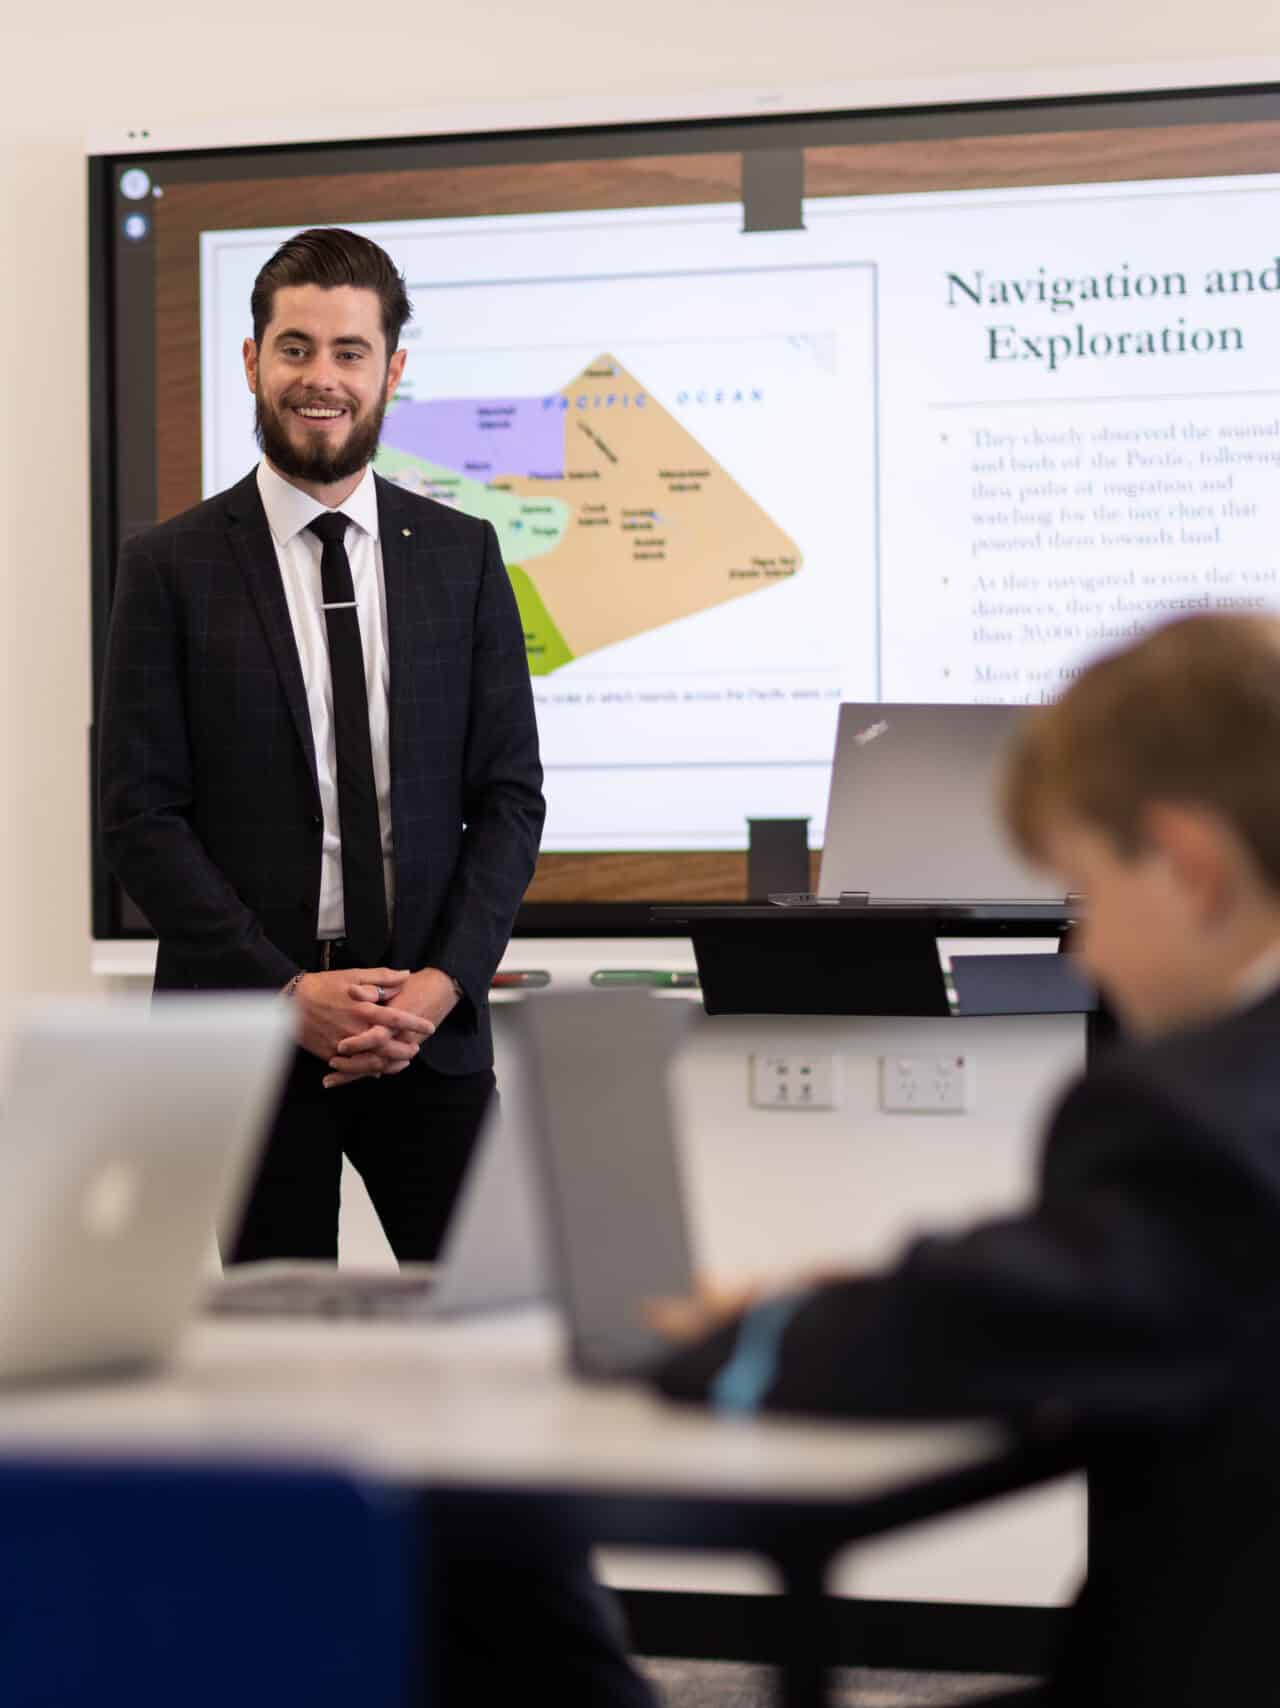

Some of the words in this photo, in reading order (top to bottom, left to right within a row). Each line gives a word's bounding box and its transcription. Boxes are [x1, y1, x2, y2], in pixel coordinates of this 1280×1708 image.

[944, 261, 1188, 312] Navigation
[1204, 256, 1280, 295] and
[984, 317, 1246, 372] Exploration
[542, 392, 648, 411] PACIFIC
[676, 387, 764, 406] OCEAN
